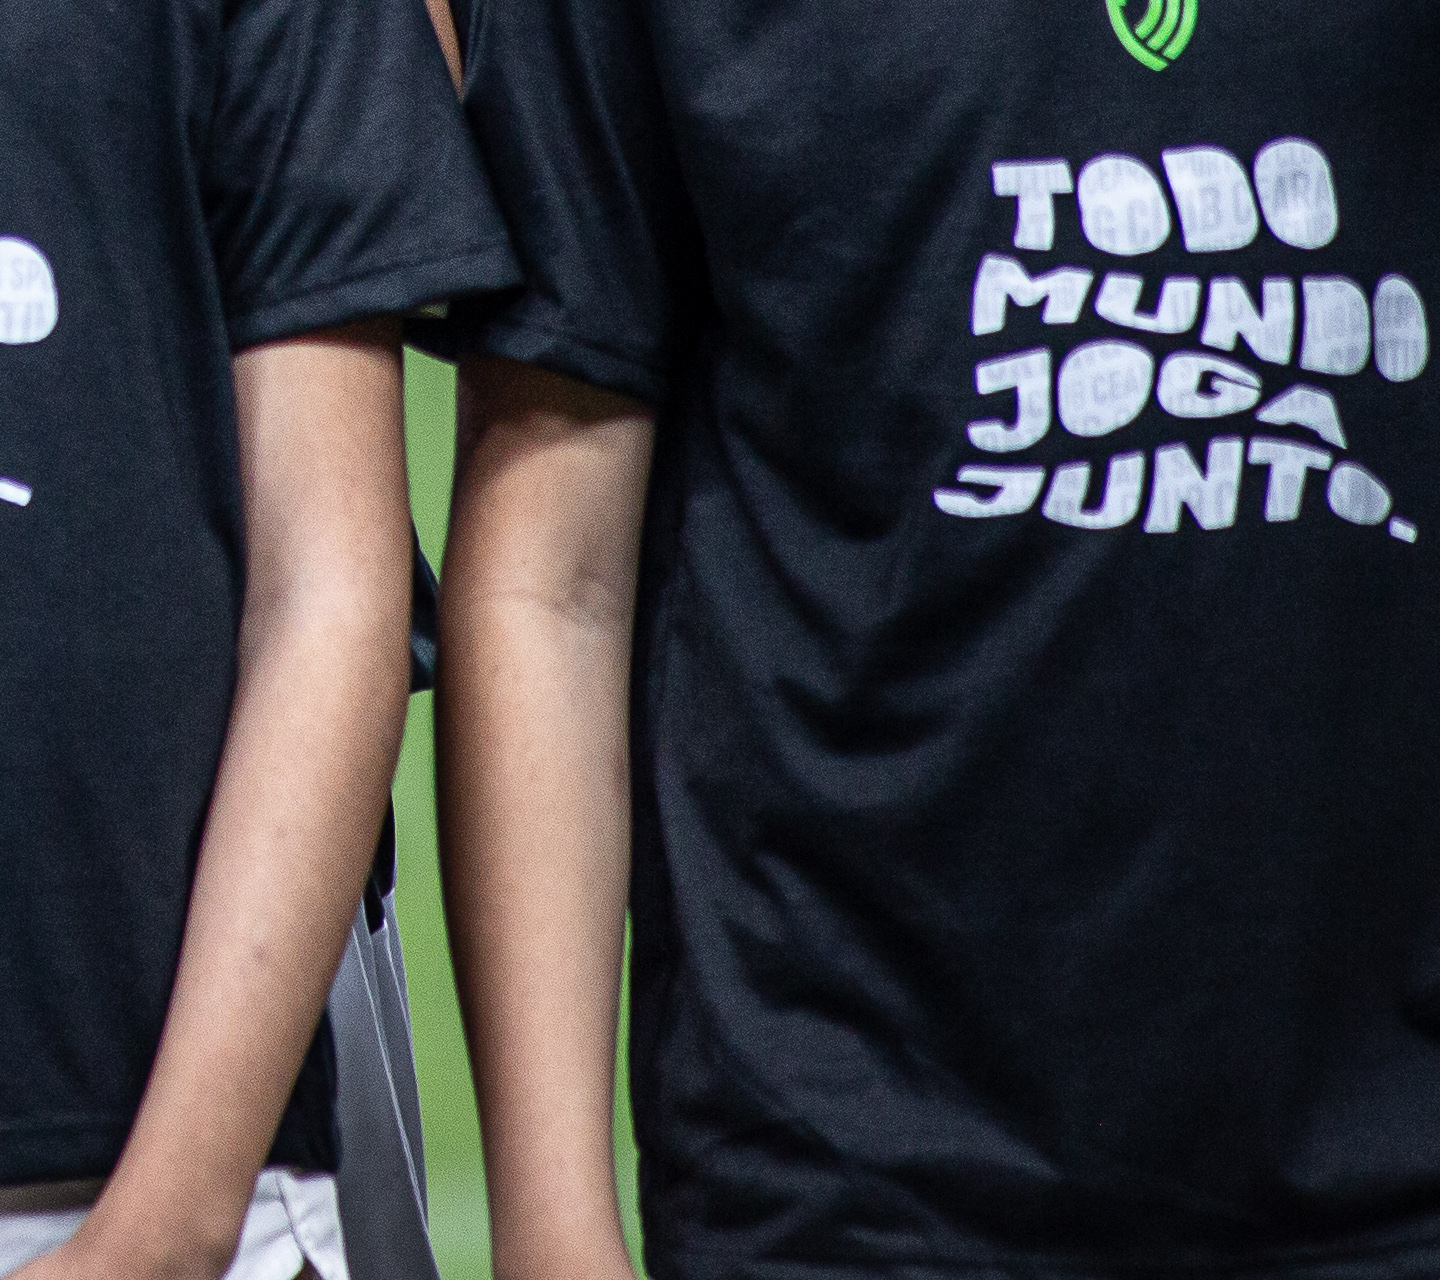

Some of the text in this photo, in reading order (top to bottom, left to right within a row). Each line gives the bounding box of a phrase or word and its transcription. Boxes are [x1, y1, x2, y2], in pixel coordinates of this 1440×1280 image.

[990, 136, 1340, 257] TODO
[970, 251, 1430, 383] MUNDO
[966, 338, 1348, 454] JOGA
[932, 436, 1419, 545] JUNTO.
